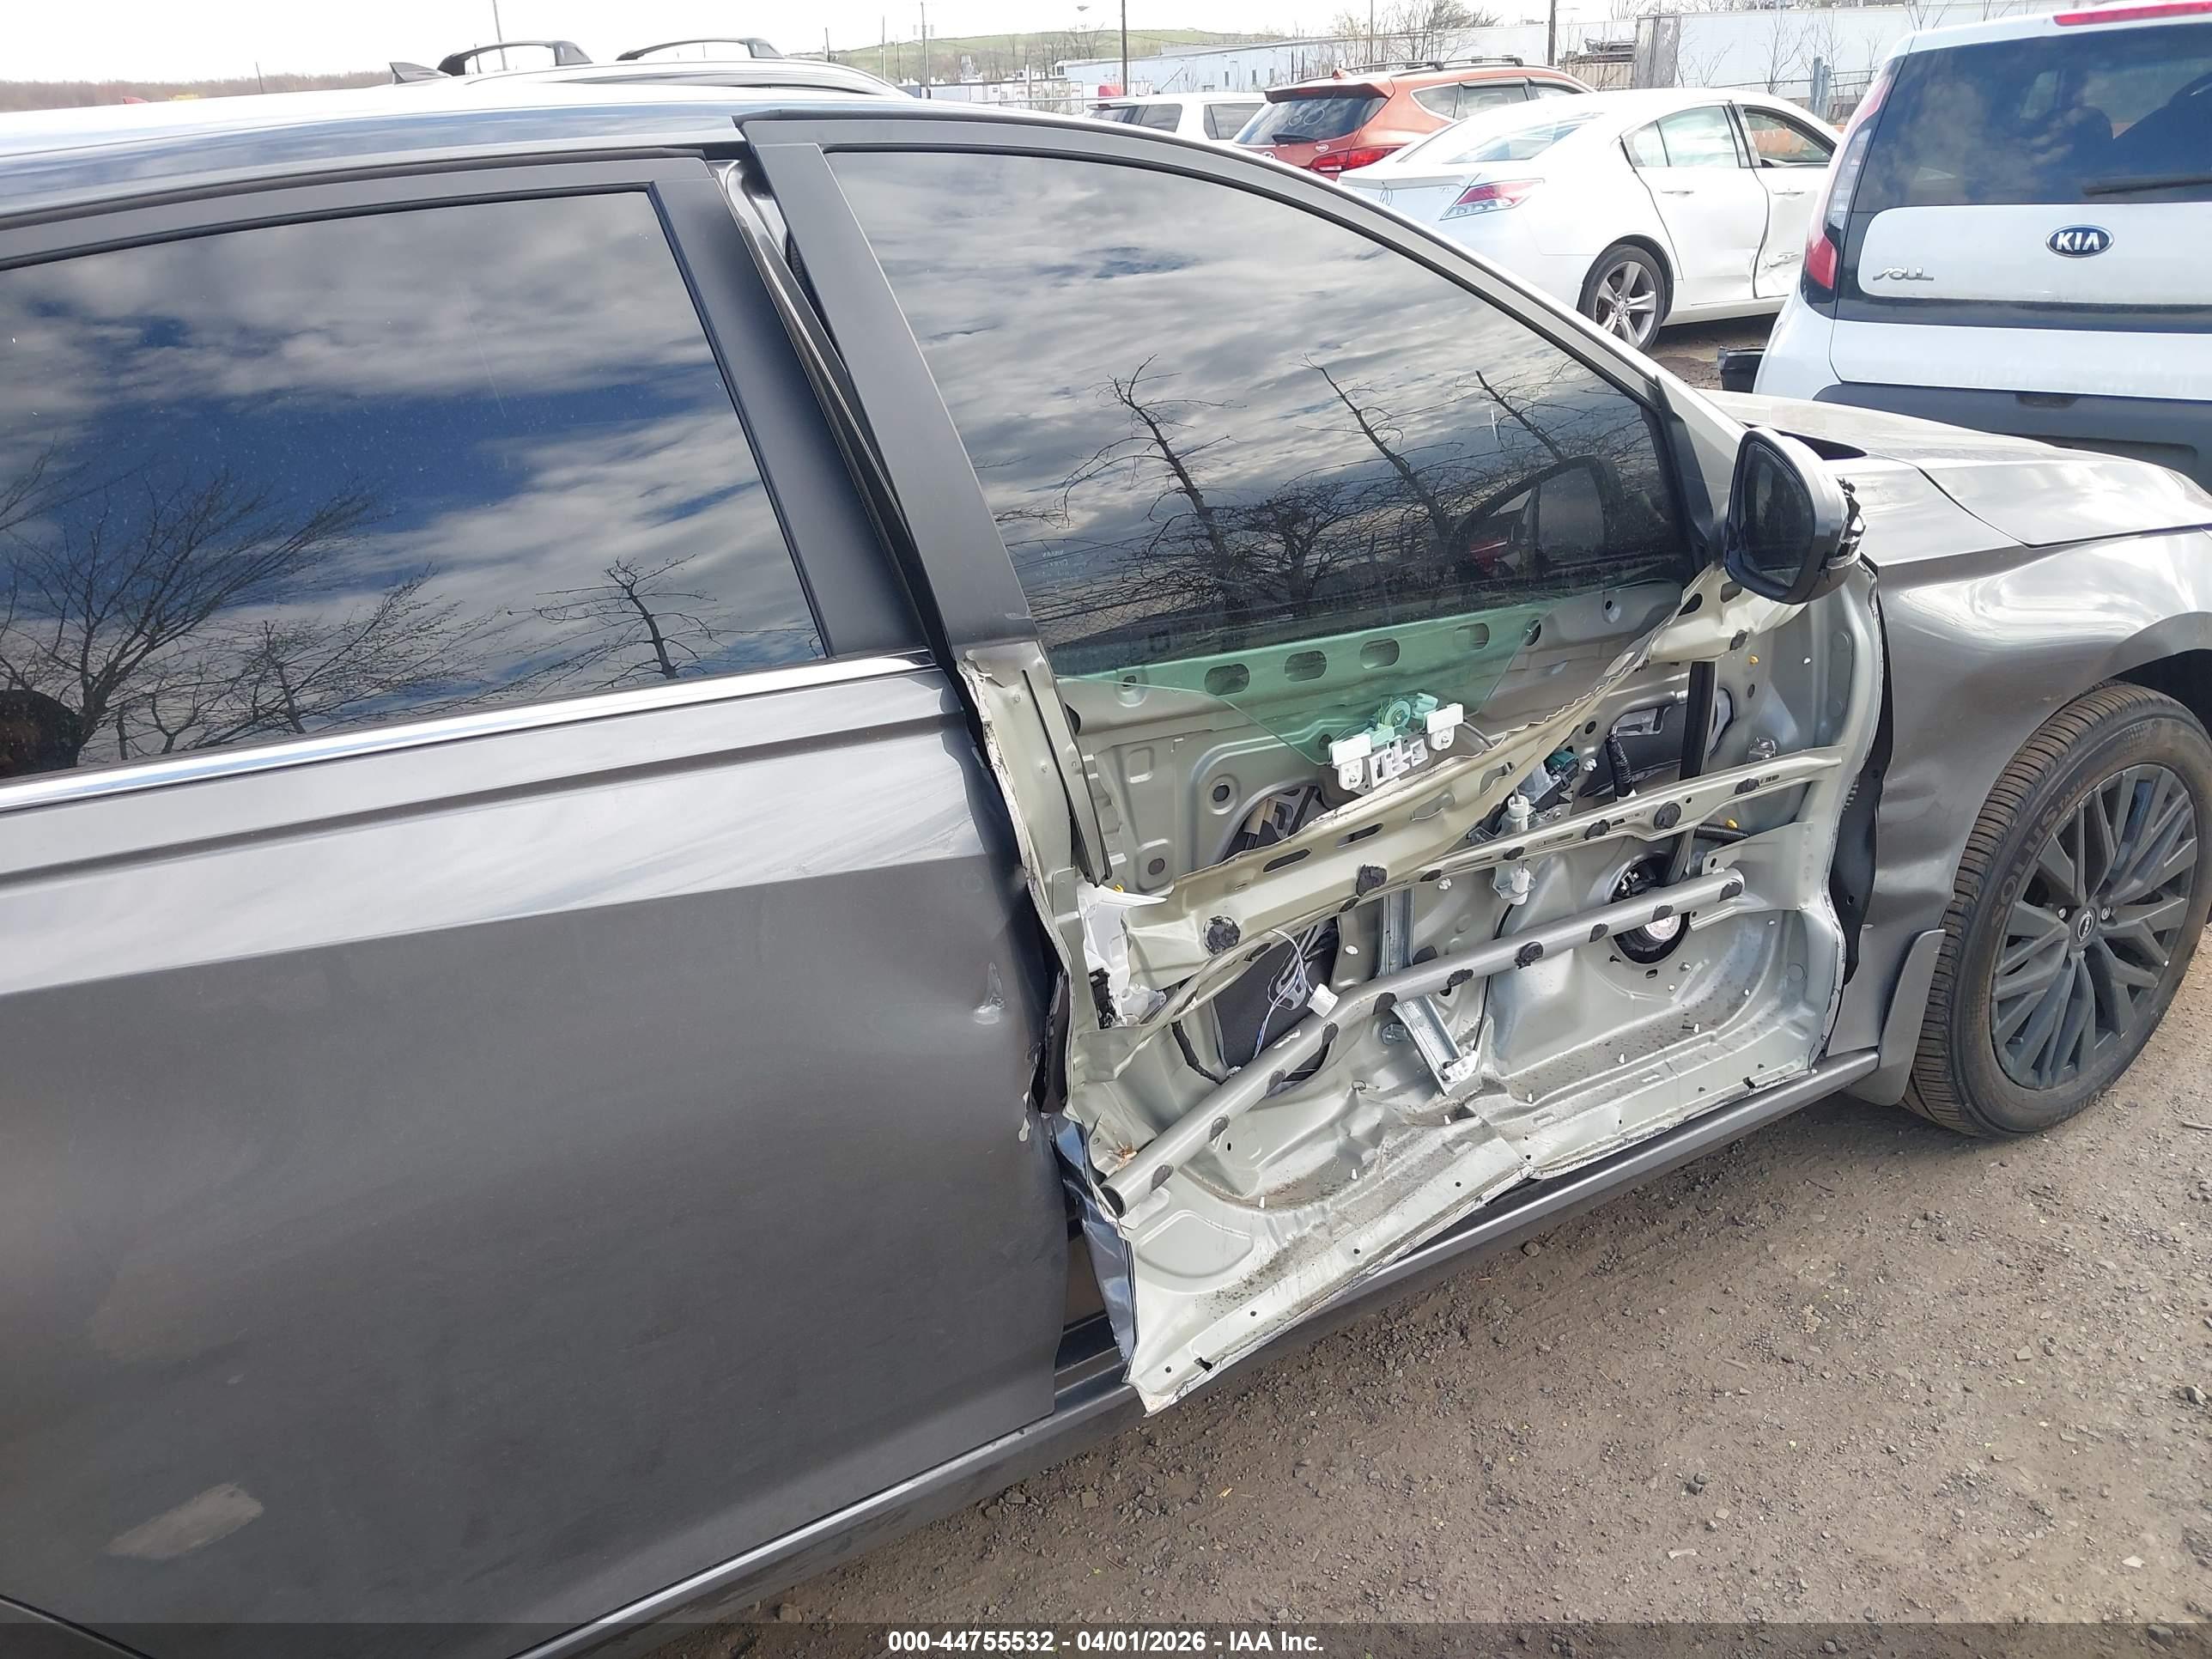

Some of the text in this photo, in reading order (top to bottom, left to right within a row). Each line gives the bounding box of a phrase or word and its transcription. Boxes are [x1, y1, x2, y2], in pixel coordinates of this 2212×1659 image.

[2057, 232, 2100, 251] KIA
[1873, 267, 1935, 282] SOUL
[1990, 805, 2059, 929] SOLUS
